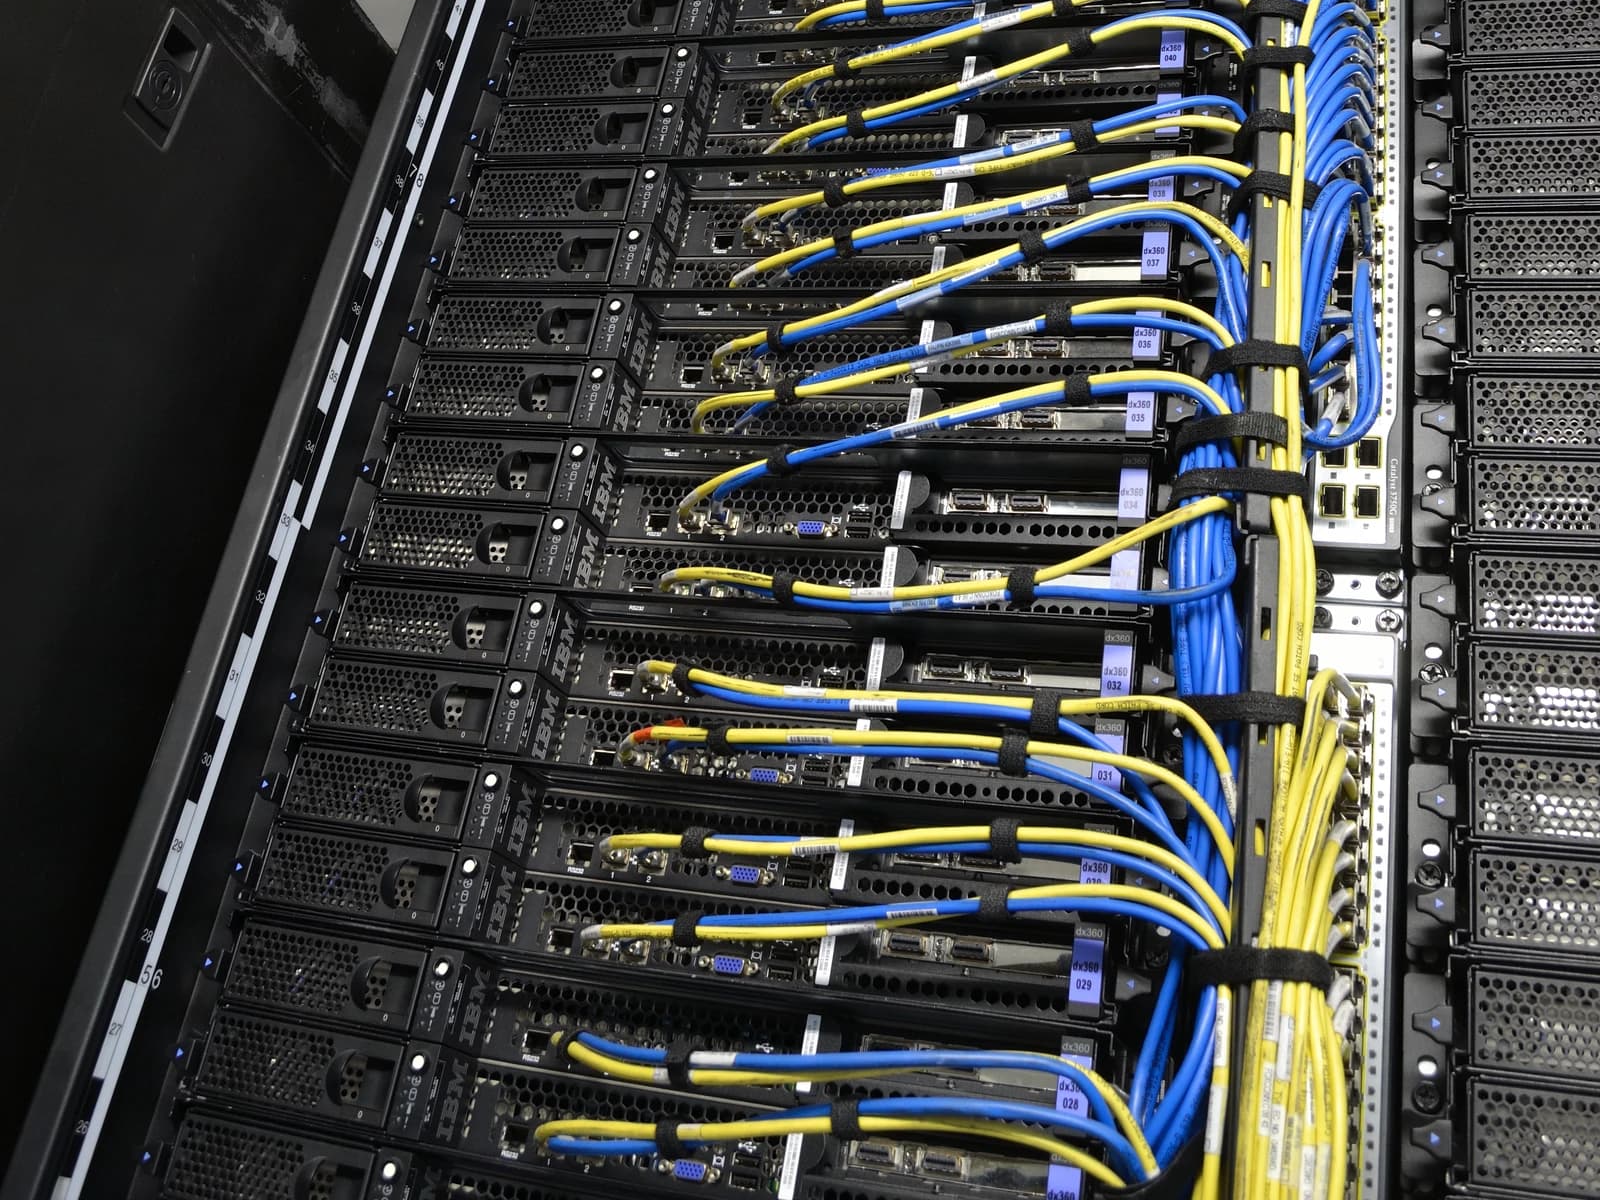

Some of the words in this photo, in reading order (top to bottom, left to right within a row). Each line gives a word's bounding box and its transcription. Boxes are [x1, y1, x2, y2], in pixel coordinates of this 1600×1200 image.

[1161, 44, 1182, 52] dx360
[1164, 54, 1177, 62] 040
[664, 181, 685, 243] IBM
[1146, 259, 1159, 267] 037
[1134, 329, 1157, 337] dx360
[629, 311, 653, 377] IBM
[1138, 340, 1151, 349] 036
[1127, 400, 1151, 409] dx360
[1131, 414, 1145, 422] 035
[1389, 458, 1399, 490] Catalyst
[592, 455, 617, 524] IBM
[1389, 491, 1398, 515] 3750G
[574, 527, 600, 589] IBM
[1296, 622, 1304, 641] CORD
[551, 611, 578, 683] IBM
[1294, 644, 1303, 669] PATCH
[1103, 666, 1128, 676] dx360
[1106, 680, 1122, 690] 032
[531, 689, 560, 760] IBM
[1095, 723, 1122, 732] dx360
[201, 751, 212, 767] 30
[1097, 770, 1113, 781] 031
[507, 783, 537, 857] IBM
[171, 837, 183, 853] 29
[1082, 862, 1108, 873] dx360
[486, 865, 516, 944] IBM
[140, 928, 153, 944] 28
[1075, 927, 1103, 938] dx360
[1072, 960, 1099, 973] dx360
[1075, 978, 1093, 991] 029
[459, 966, 491, 1046] IBM
[108, 1022, 122, 1036] 27
[1061, 1041, 1090, 1053] dx360
[436, 1058, 469, 1142] IBM
[1062, 1097, 1079, 1110] 028
[75, 1120, 88, 1135] 26
